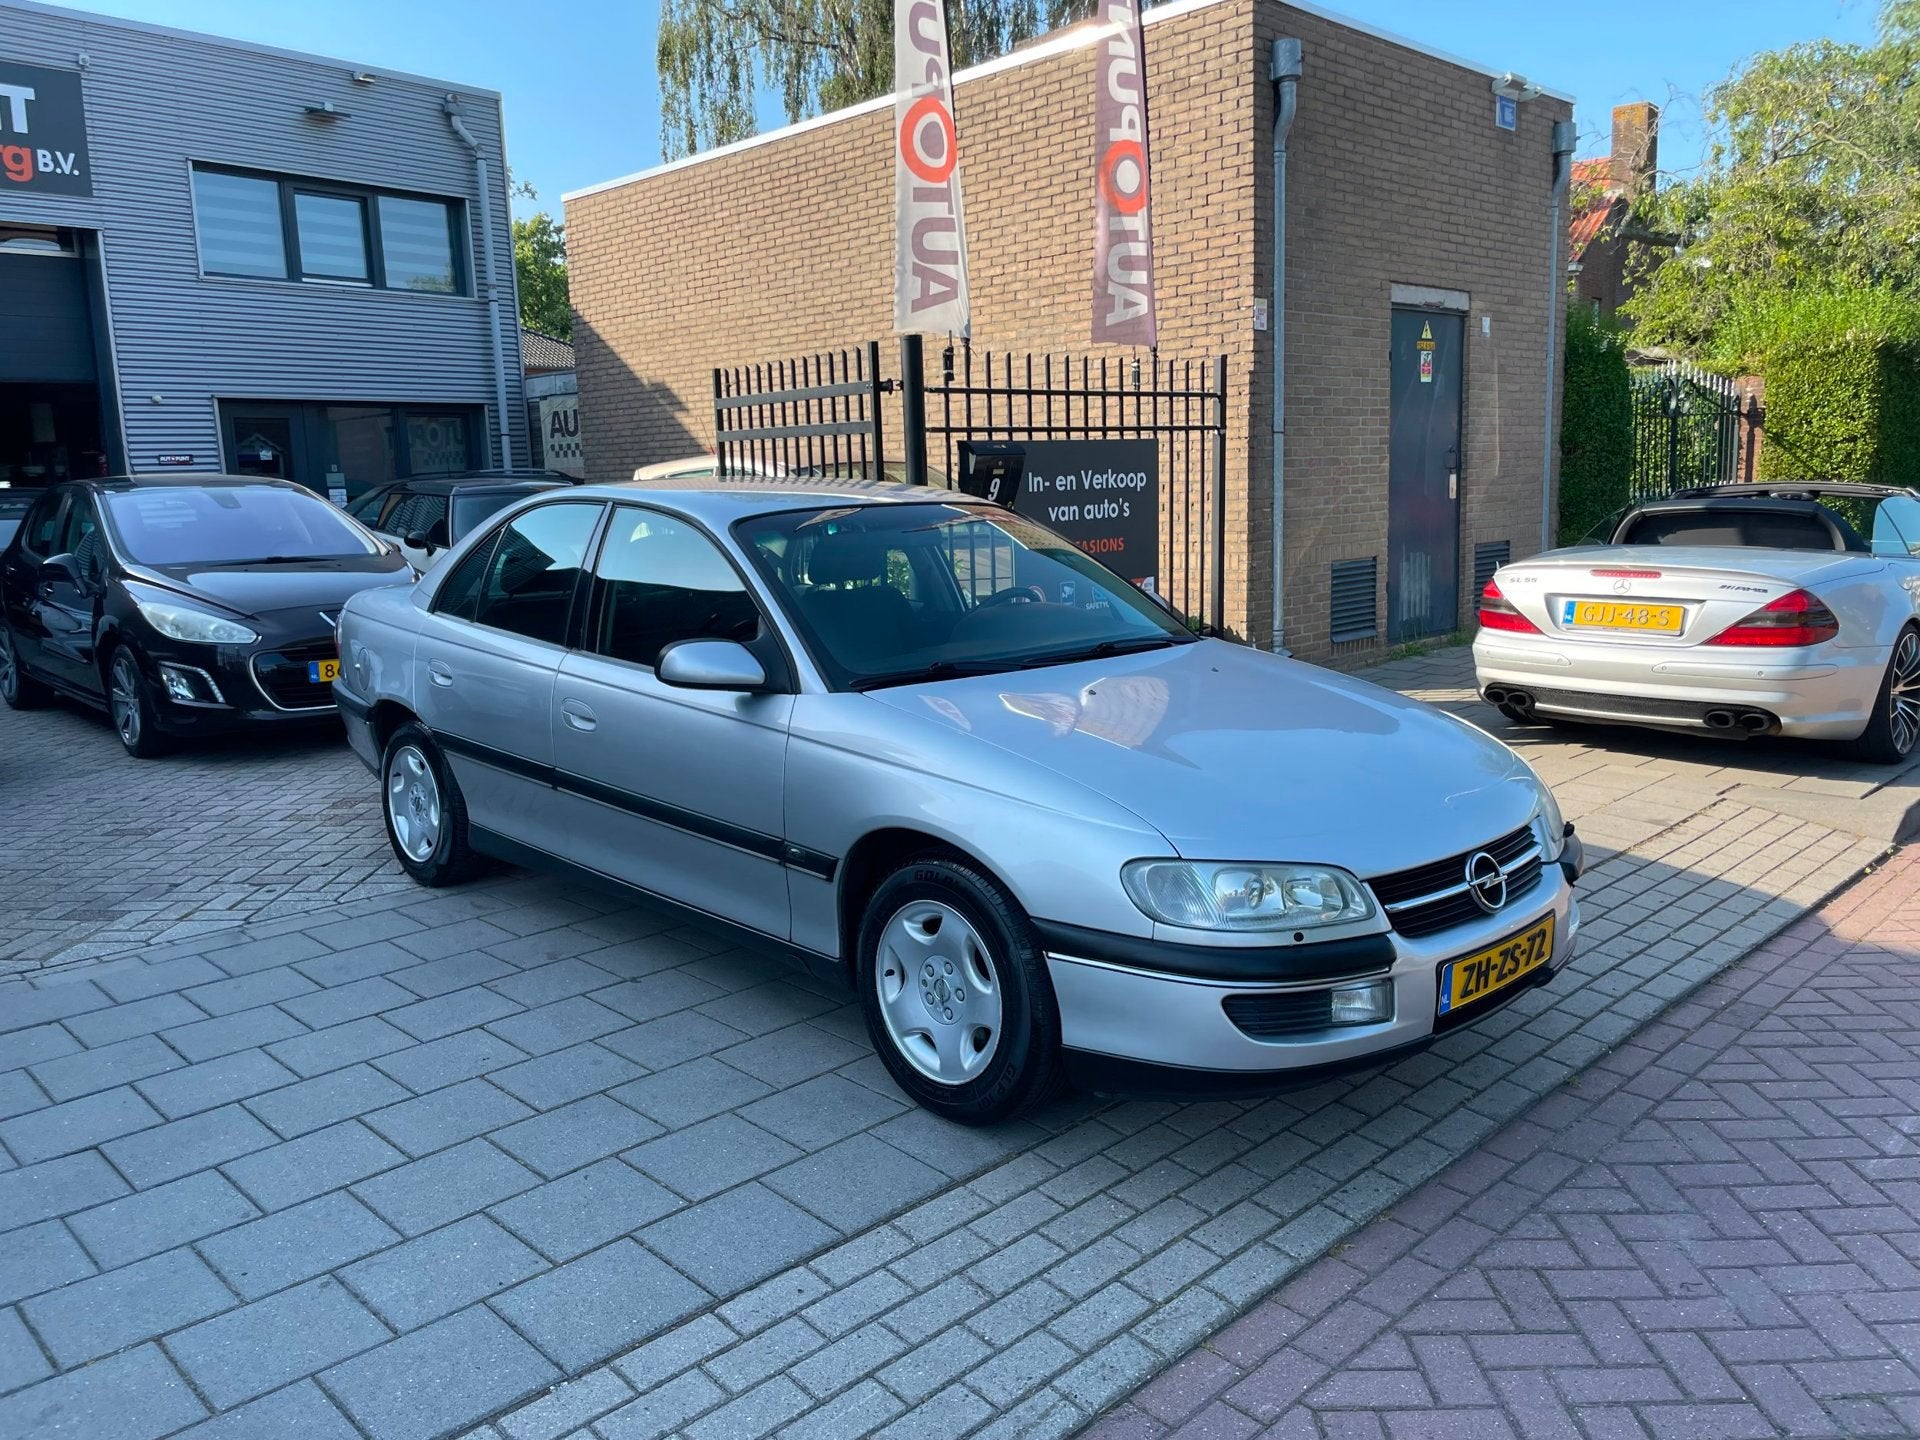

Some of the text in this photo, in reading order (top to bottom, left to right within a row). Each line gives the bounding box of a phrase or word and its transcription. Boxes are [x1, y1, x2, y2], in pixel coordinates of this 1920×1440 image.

[0, 83, 36, 134] T
[0, 144, 80, 183] g B.V.
[550, 408, 579, 439] AU
[987, 477, 1001, 501] 9
[1028, 469, 1147, 493] In- en Verkoop
[1048, 498, 1130, 522] van auto's
[1075, 537, 1125, 554] ASIONS
[1583, 605, 1670, 627] GJJ-48-S
[325, 664, 340, 679] 8
[1461, 928, 1547, 999] ZH-ZS-72
